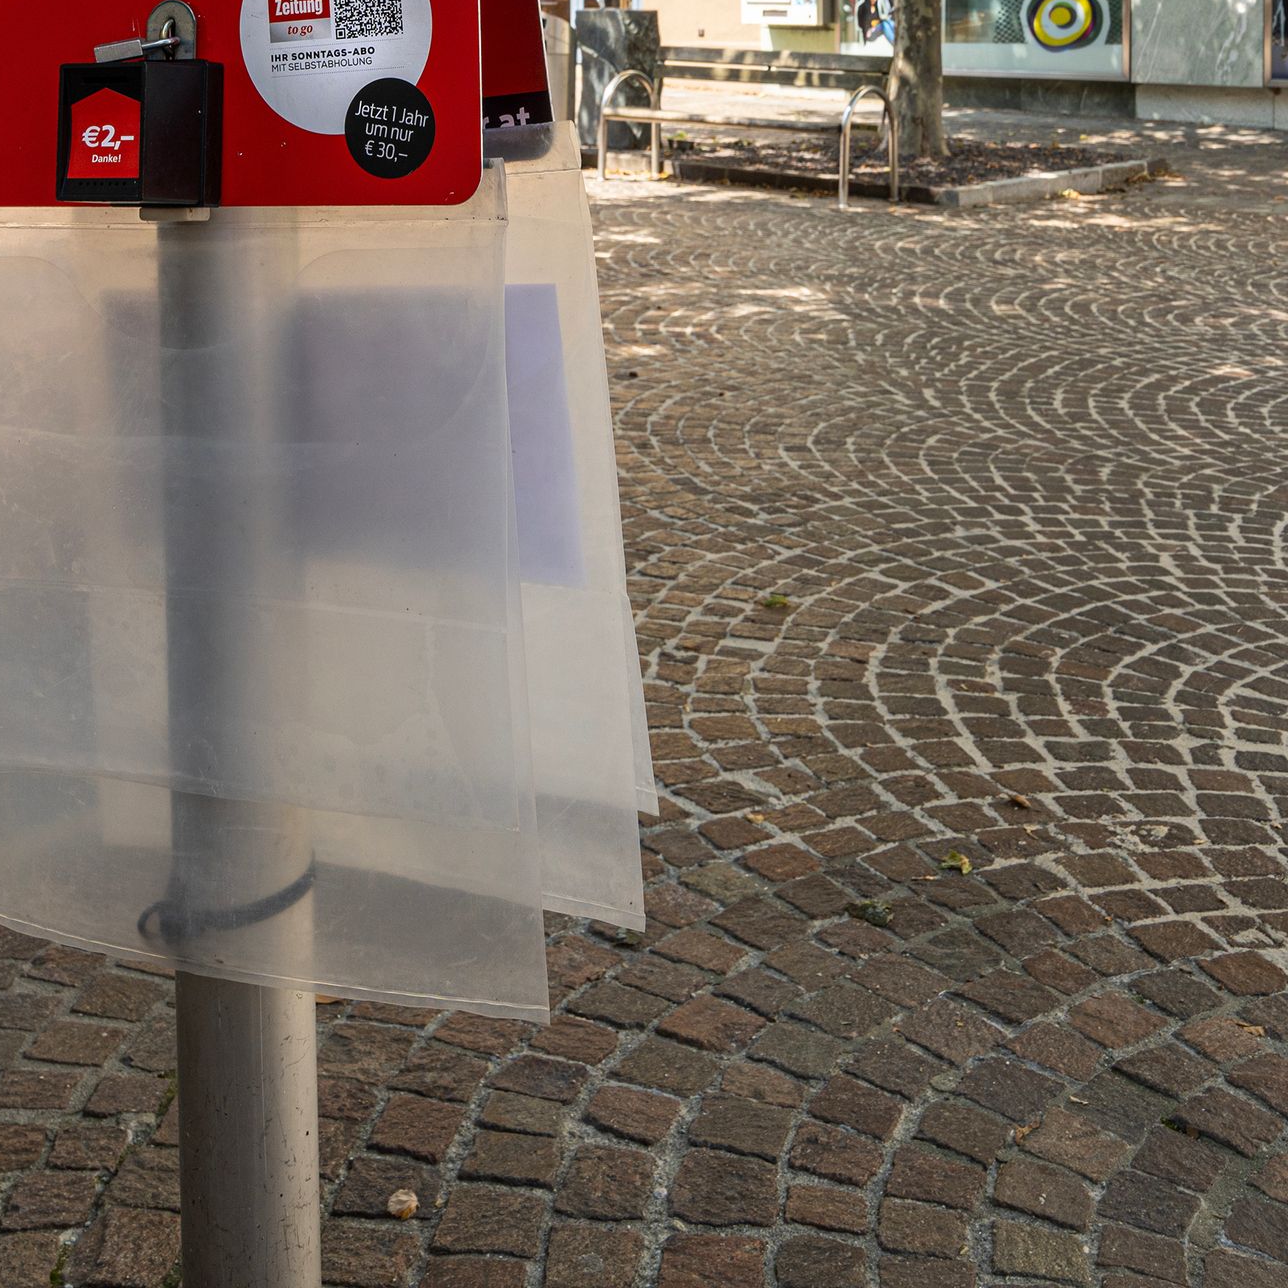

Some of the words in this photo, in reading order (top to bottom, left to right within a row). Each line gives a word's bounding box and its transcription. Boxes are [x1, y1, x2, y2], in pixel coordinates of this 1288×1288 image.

[287, 24, 299, 35] to
[300, 24, 313, 37] go
[271, 54, 289, 63] IHR
[291, 46, 376, 62] SONNTAGS-ABO
[271, 63, 287, 73] MIT
[288, 57, 373, 72] SELBSTABHOLUNG
[355, 101, 389, 121] Jetzt
[392, 105, 397, 122] 1
[399, 107, 430, 128] Jahr
[365, 122, 389, 138] um
[390, 127, 414, 142] nur
[365, 140, 374, 156] €
[91, 154, 122, 163] Danke!
